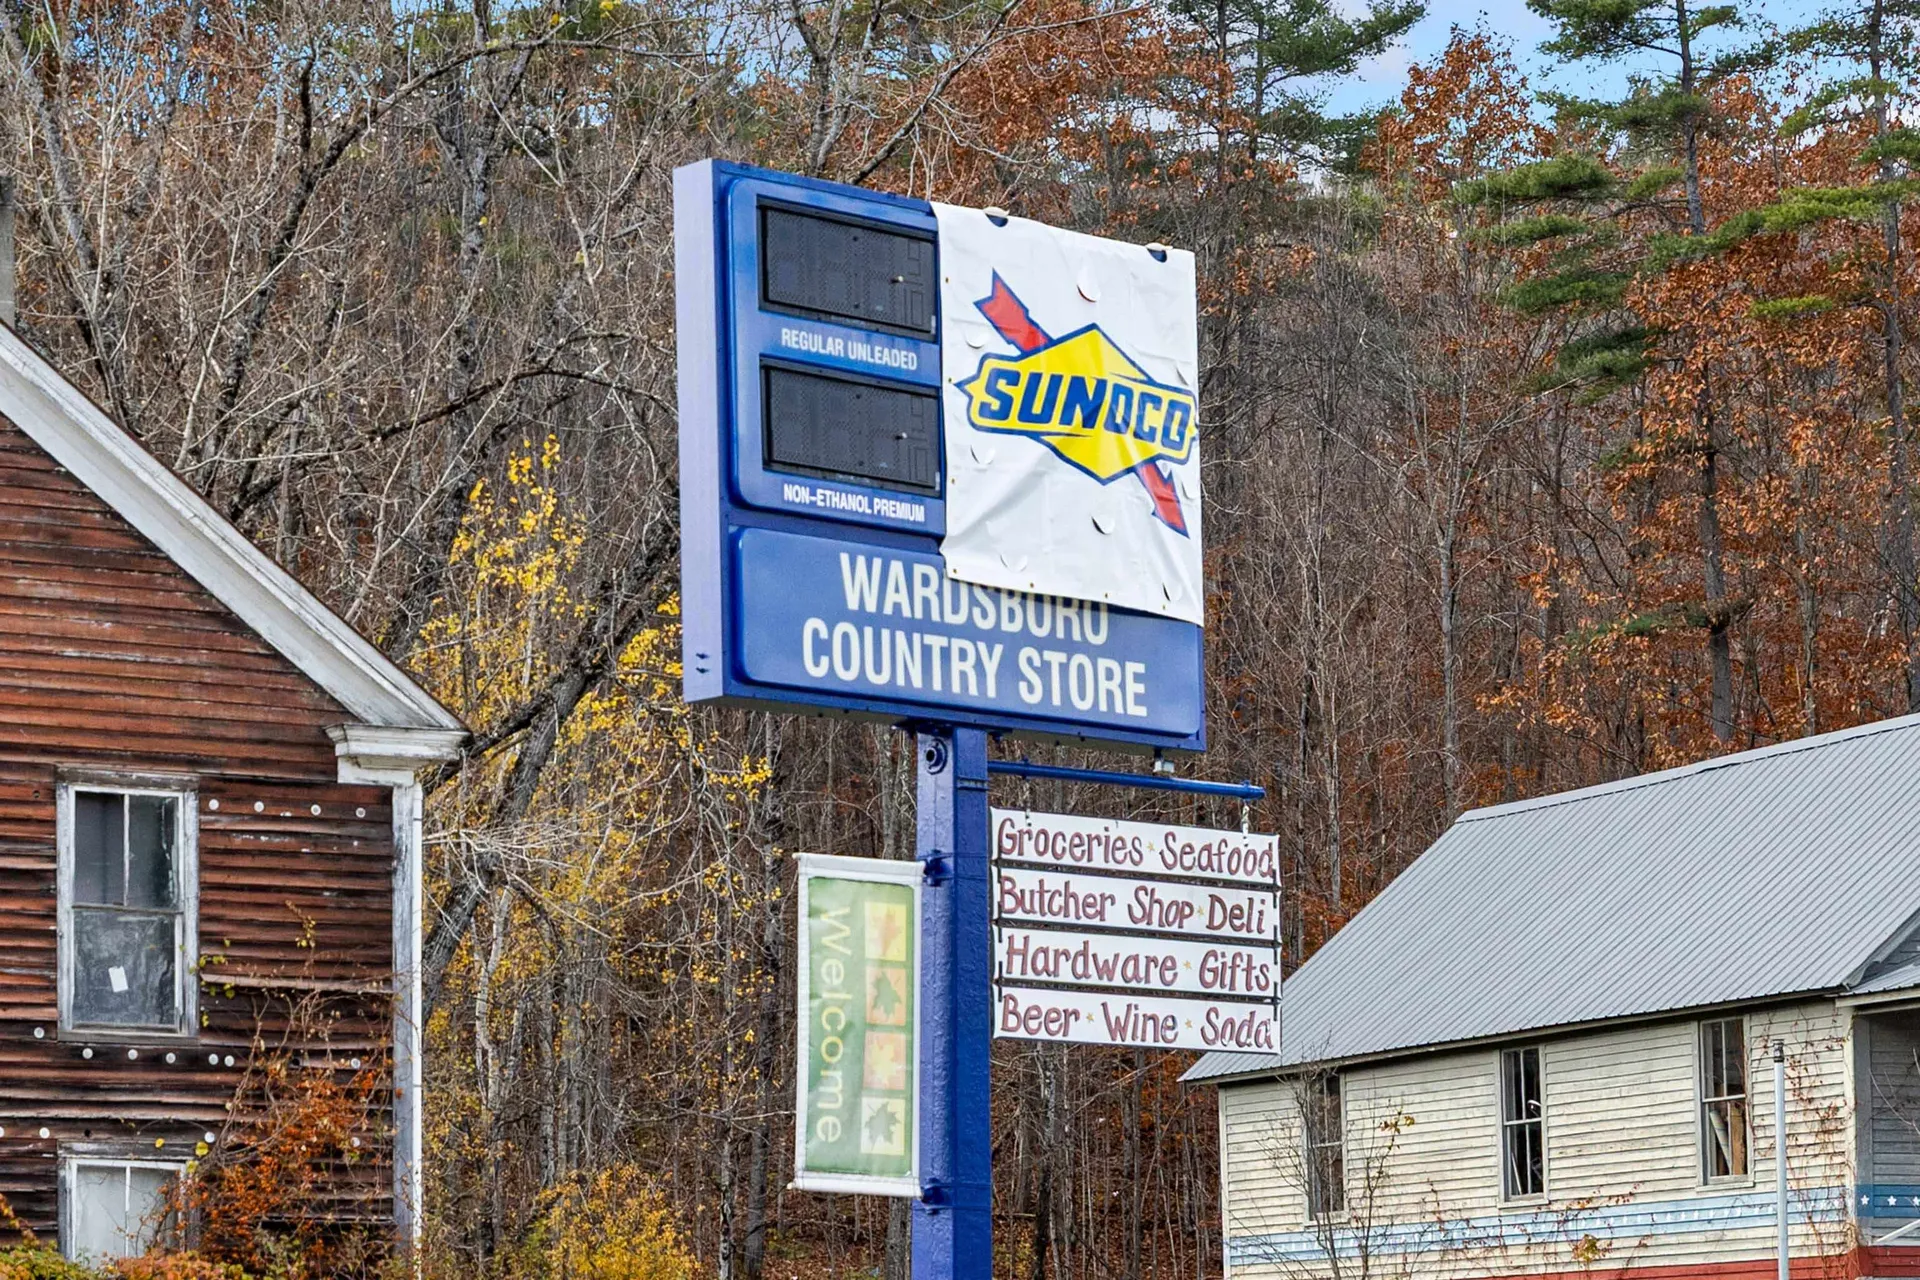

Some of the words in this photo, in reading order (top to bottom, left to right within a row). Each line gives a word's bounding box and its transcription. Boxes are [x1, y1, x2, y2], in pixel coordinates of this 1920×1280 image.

[781, 328, 844, 357] REGULAR
[849, 340, 917, 370] UNLEADED
[978, 367, 1192, 452] SUNOCO
[783, 483, 872, 514] NON-ETHANOL
[873, 498, 925, 522] PREMIUM
[802, 617, 1004, 698] COUNTRY
[1018, 646, 1148, 717] STORE
[999, 817, 1143, 866] Groceries
[1159, 831, 1274, 878] Seafood
[1000, 875, 1116, 922] Butcher
[1127, 885, 1194, 929] Shop
[1206, 894, 1266, 934] Deli
[1006, 934, 1178, 986] Hardware
[1199, 949, 1270, 992] Gifts
[816, 908, 852, 1143] Welcome
[1000, 993, 1080, 1037] Beer
[1101, 1001, 1179, 1043] Wine
[1200, 1006, 1274, 1049] Soda
